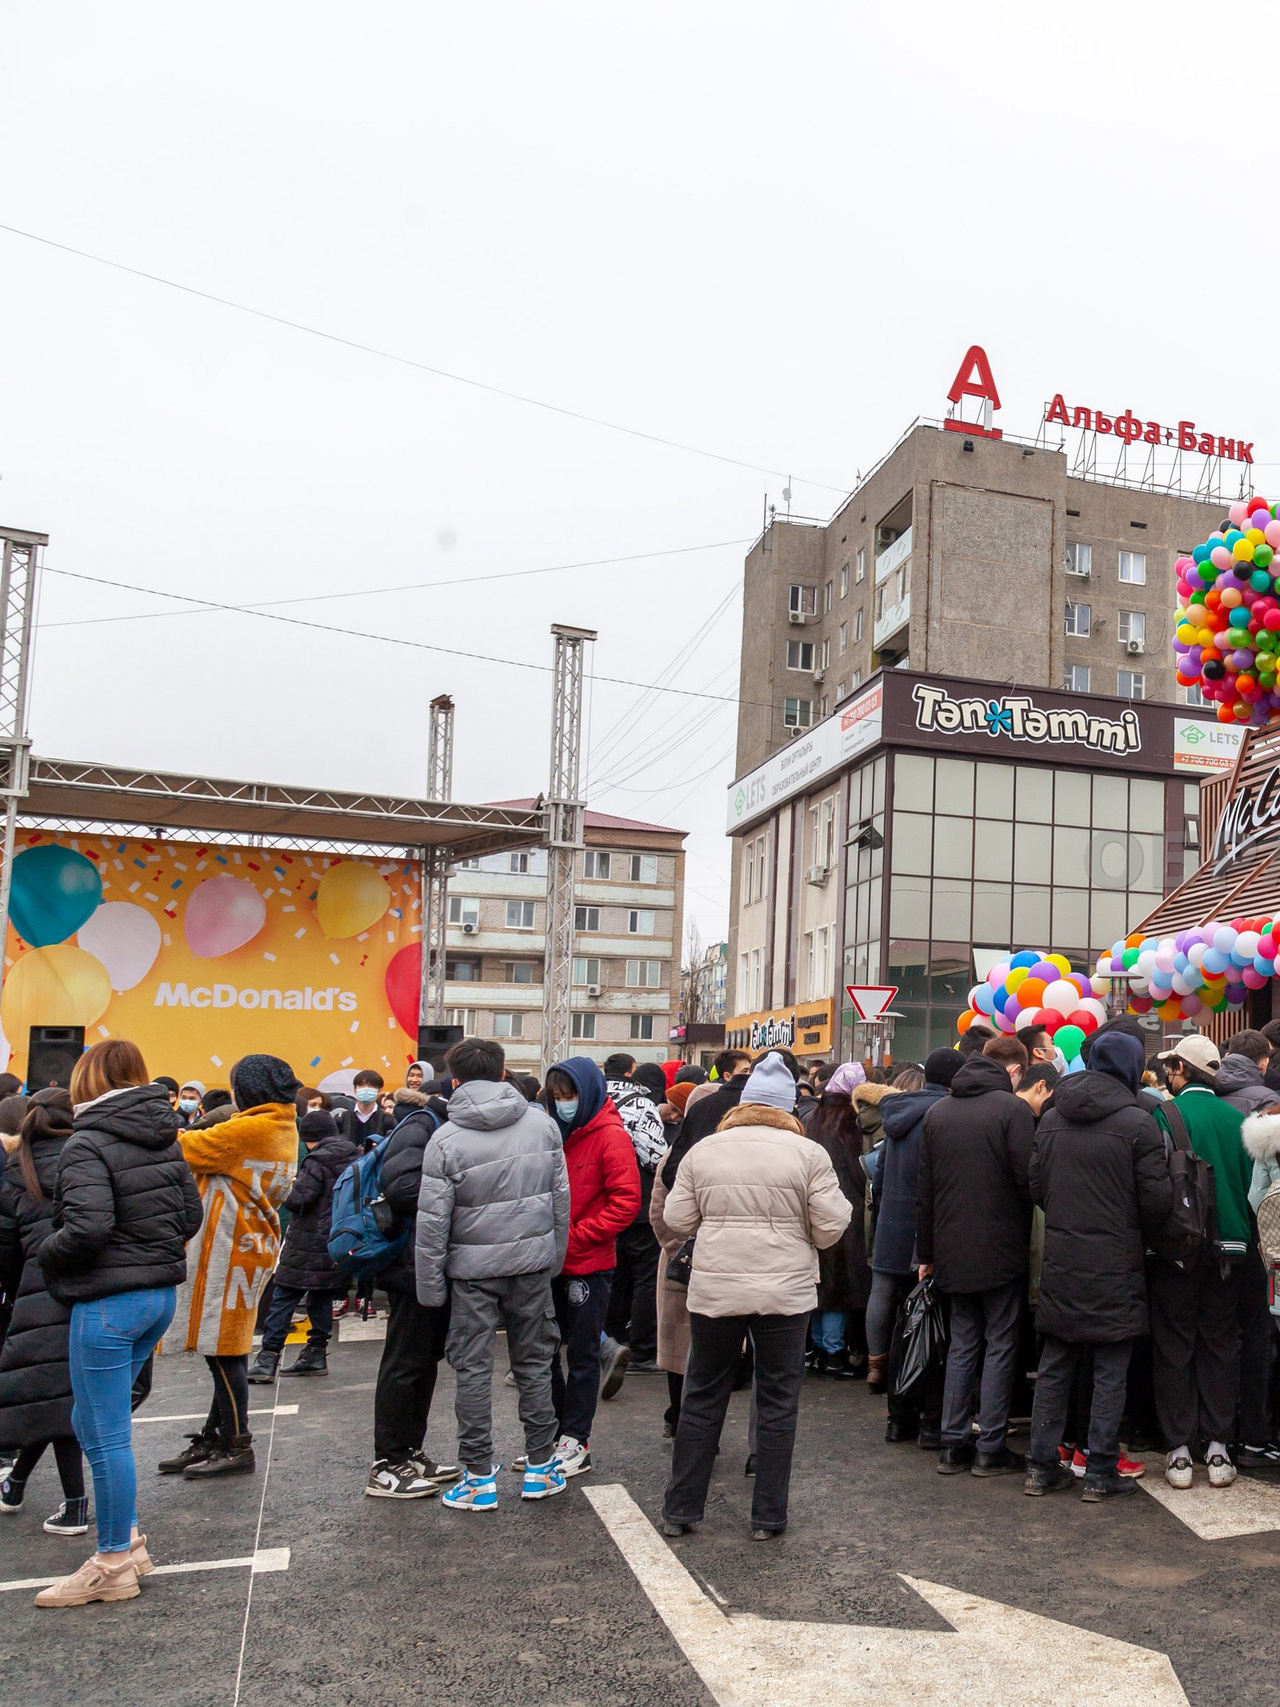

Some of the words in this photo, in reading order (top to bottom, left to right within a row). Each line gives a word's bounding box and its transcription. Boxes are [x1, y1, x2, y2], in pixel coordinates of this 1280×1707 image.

[1210, 732, 1239, 746] LETS
[746, 774, 766, 810] LETS
[154, 982, 358, 1012] McDonald's
